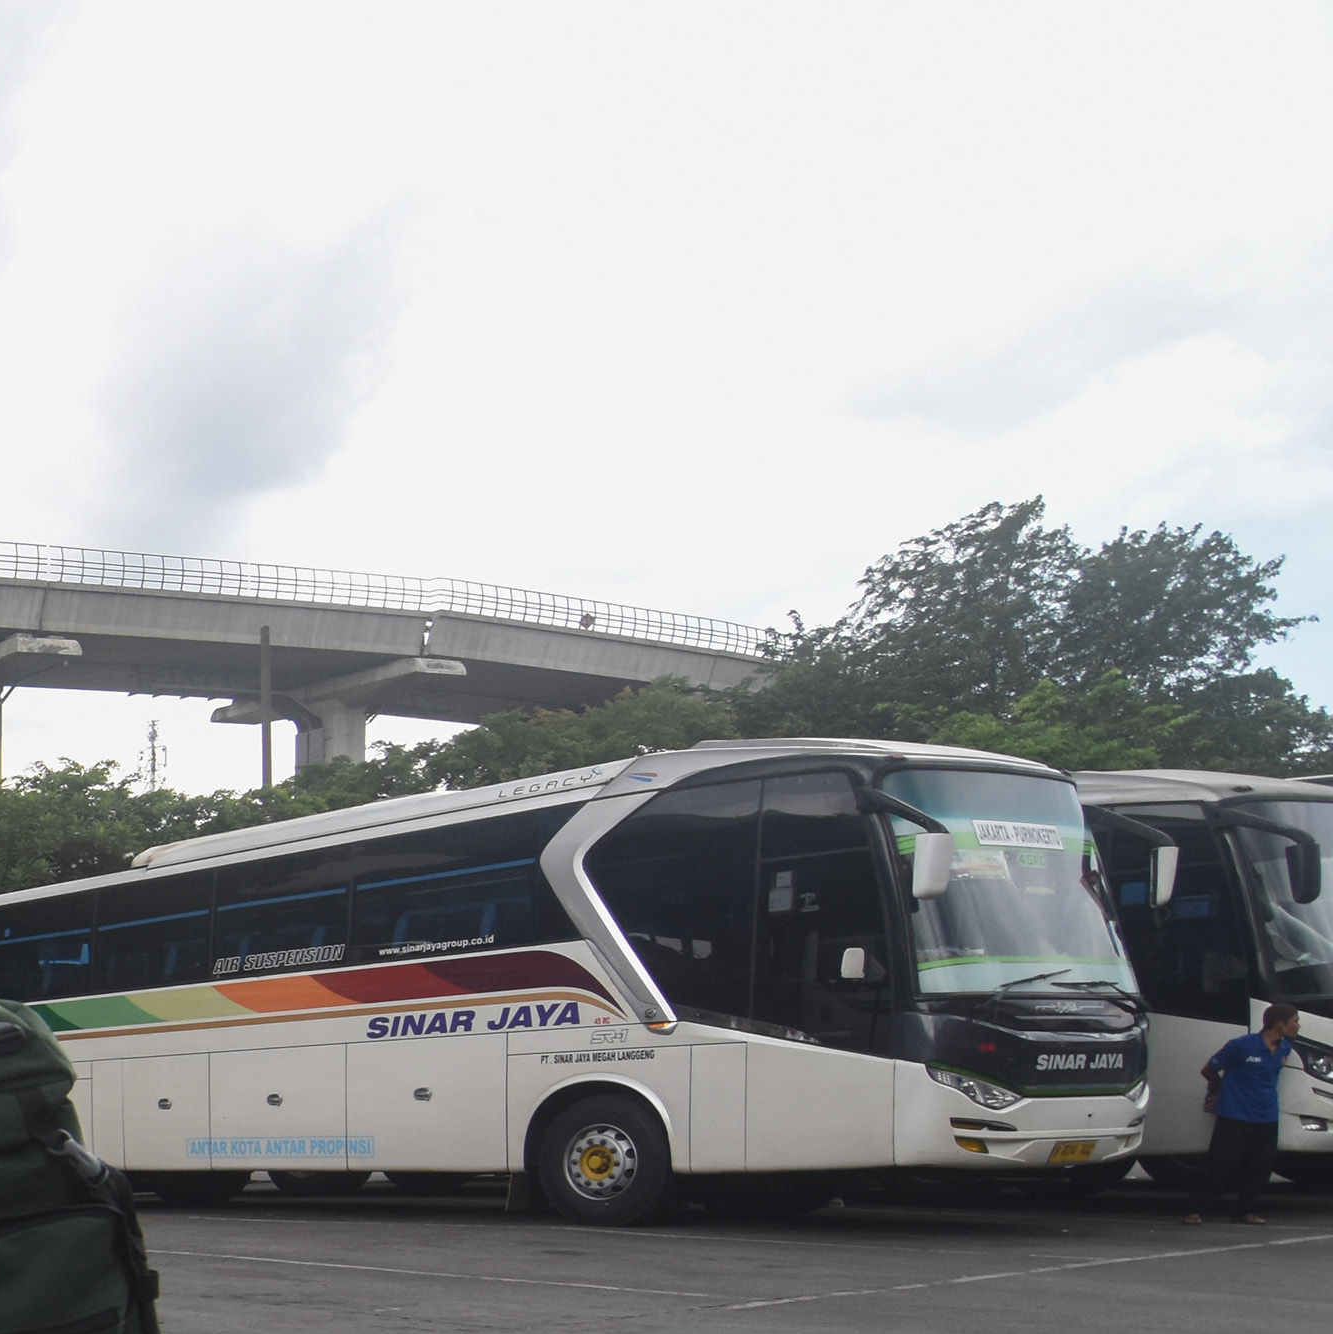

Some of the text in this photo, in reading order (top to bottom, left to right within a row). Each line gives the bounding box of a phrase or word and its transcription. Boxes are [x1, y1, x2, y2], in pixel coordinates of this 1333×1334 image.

[498, 773, 593, 798] LEGACY
[978, 824, 1011, 842] JAKARTA
[1014, 826, 1060, 847] PURWOKERTO
[378, 935, 495, 956] www.sinarjayagroup.co.id
[213, 944, 345, 975] AIR SUSPENSION
[366, 1002, 581, 1039] SINAR JAYA
[590, 1029, 628, 1044] SR-1
[554, 1054, 573, 1064] SINAR
[574, 1053, 591, 1063] JAYA
[592, 1051, 616, 1062] MEGAH
[617, 1049, 655, 1060] LANGGENG
[1036, 1053, 1124, 1071] SINAR JAYA
[190, 1138, 371, 1155] ANTAR KOTA ANTAR PROPINSI
